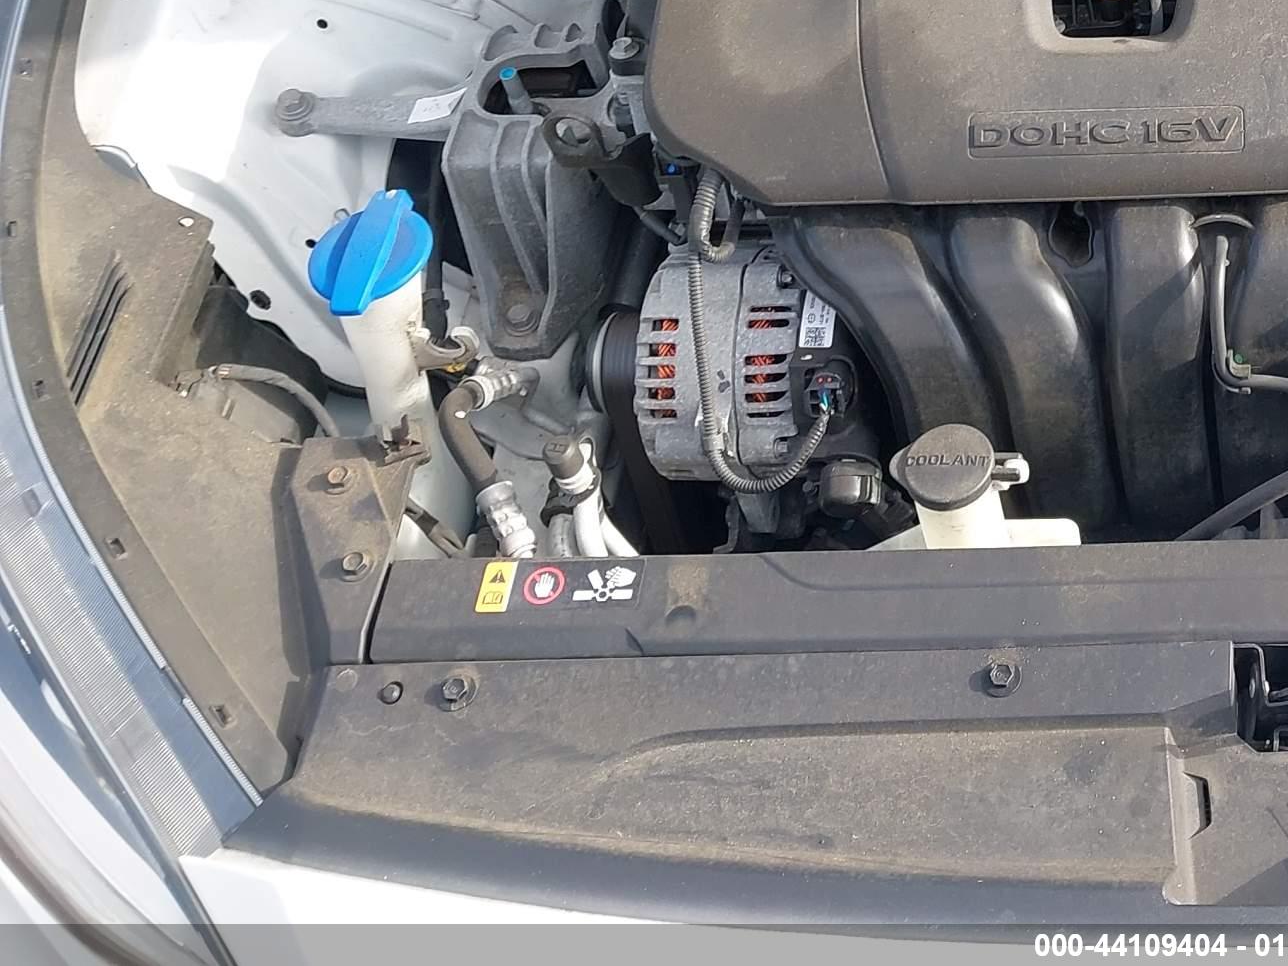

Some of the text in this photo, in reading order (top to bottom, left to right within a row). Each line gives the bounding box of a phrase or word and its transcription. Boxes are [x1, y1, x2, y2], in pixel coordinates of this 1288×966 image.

[968, 116, 1239, 149] DOHC 16V
[906, 454, 990, 467] COOLANT
